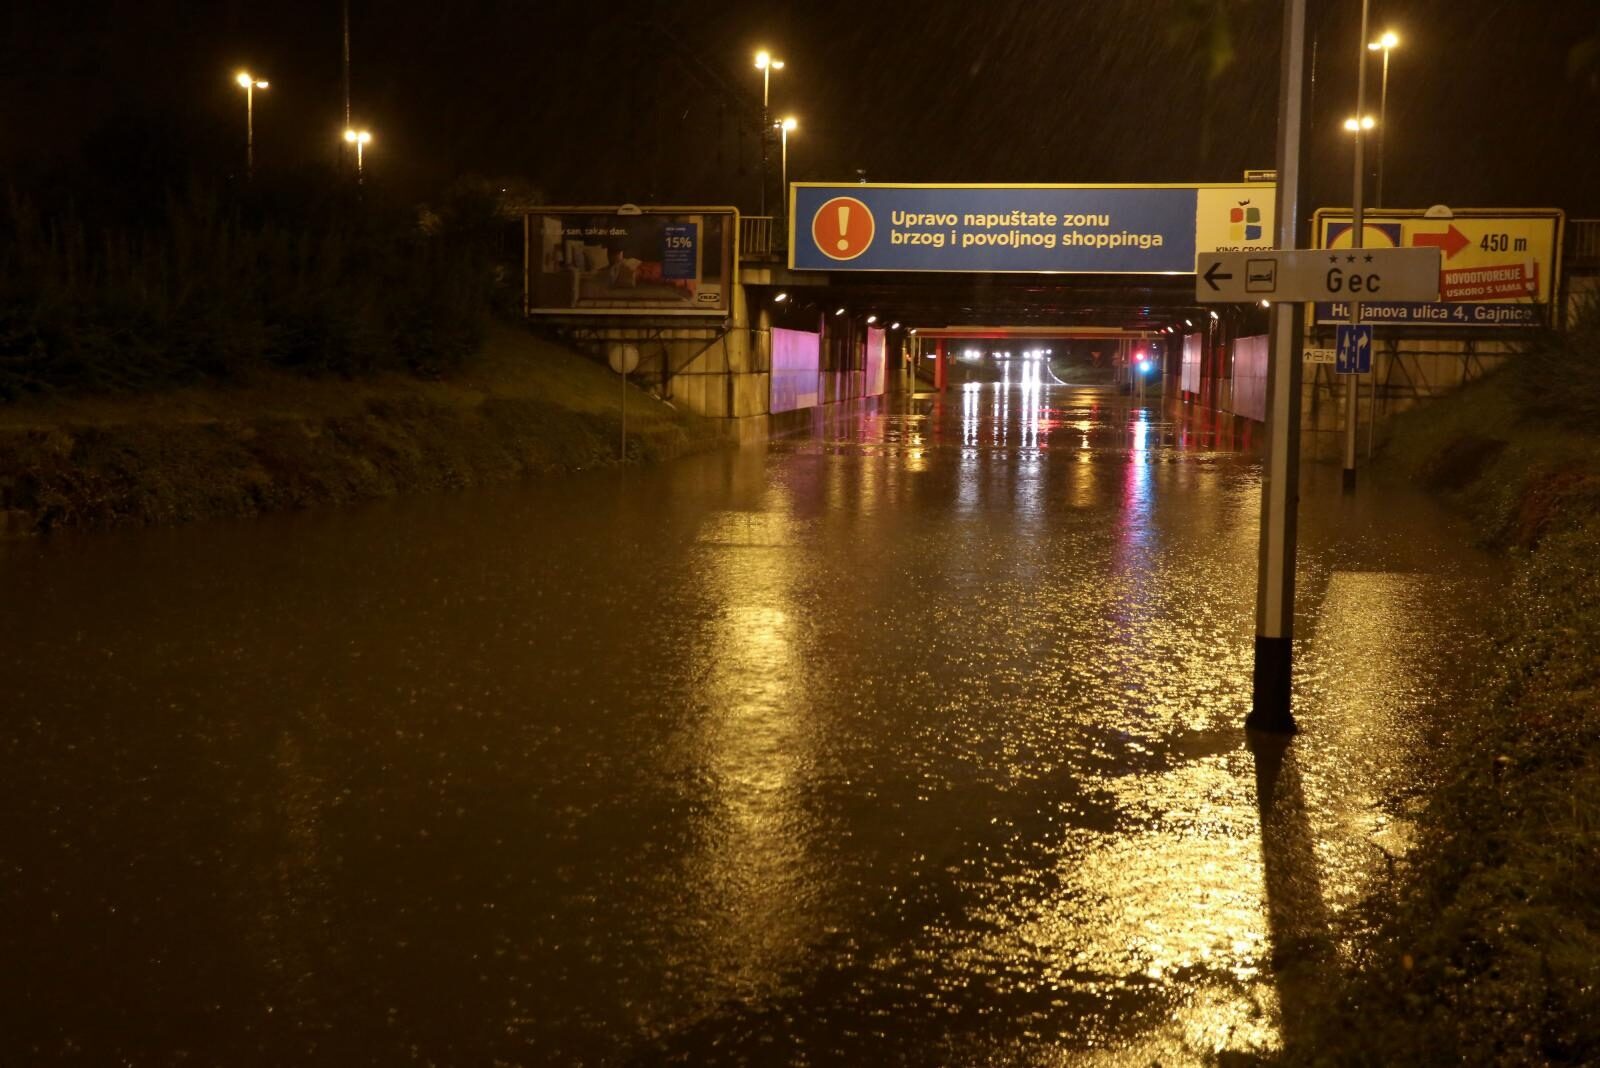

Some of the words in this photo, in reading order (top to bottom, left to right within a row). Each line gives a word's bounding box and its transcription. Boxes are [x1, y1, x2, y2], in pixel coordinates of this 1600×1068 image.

[891, 210, 958, 228] Upravo
[964, 210, 1057, 229] napuštate
[1063, 214, 1109, 226] zonu
[664, 235, 693, 249] 15%
[890, 229, 945, 247] brzog
[951, 230, 957, 245] i
[962, 230, 1057, 248] povoljnog
[1062, 230, 1163, 249] shoppinga
[1480, 234, 1508, 252] 450
[1514, 237, 1527, 252] m
[1326, 267, 1380, 293] Gec
[1445, 267, 1521, 285] NOVOOTVORENJE
[1446, 286, 1485, 298] USKORO
[1495, 282, 1523, 293] VAMA
[1412, 304, 1449, 319] ulica
[1453, 305, 1469, 321] 4,
[1474, 305, 1533, 323] Gajnice
